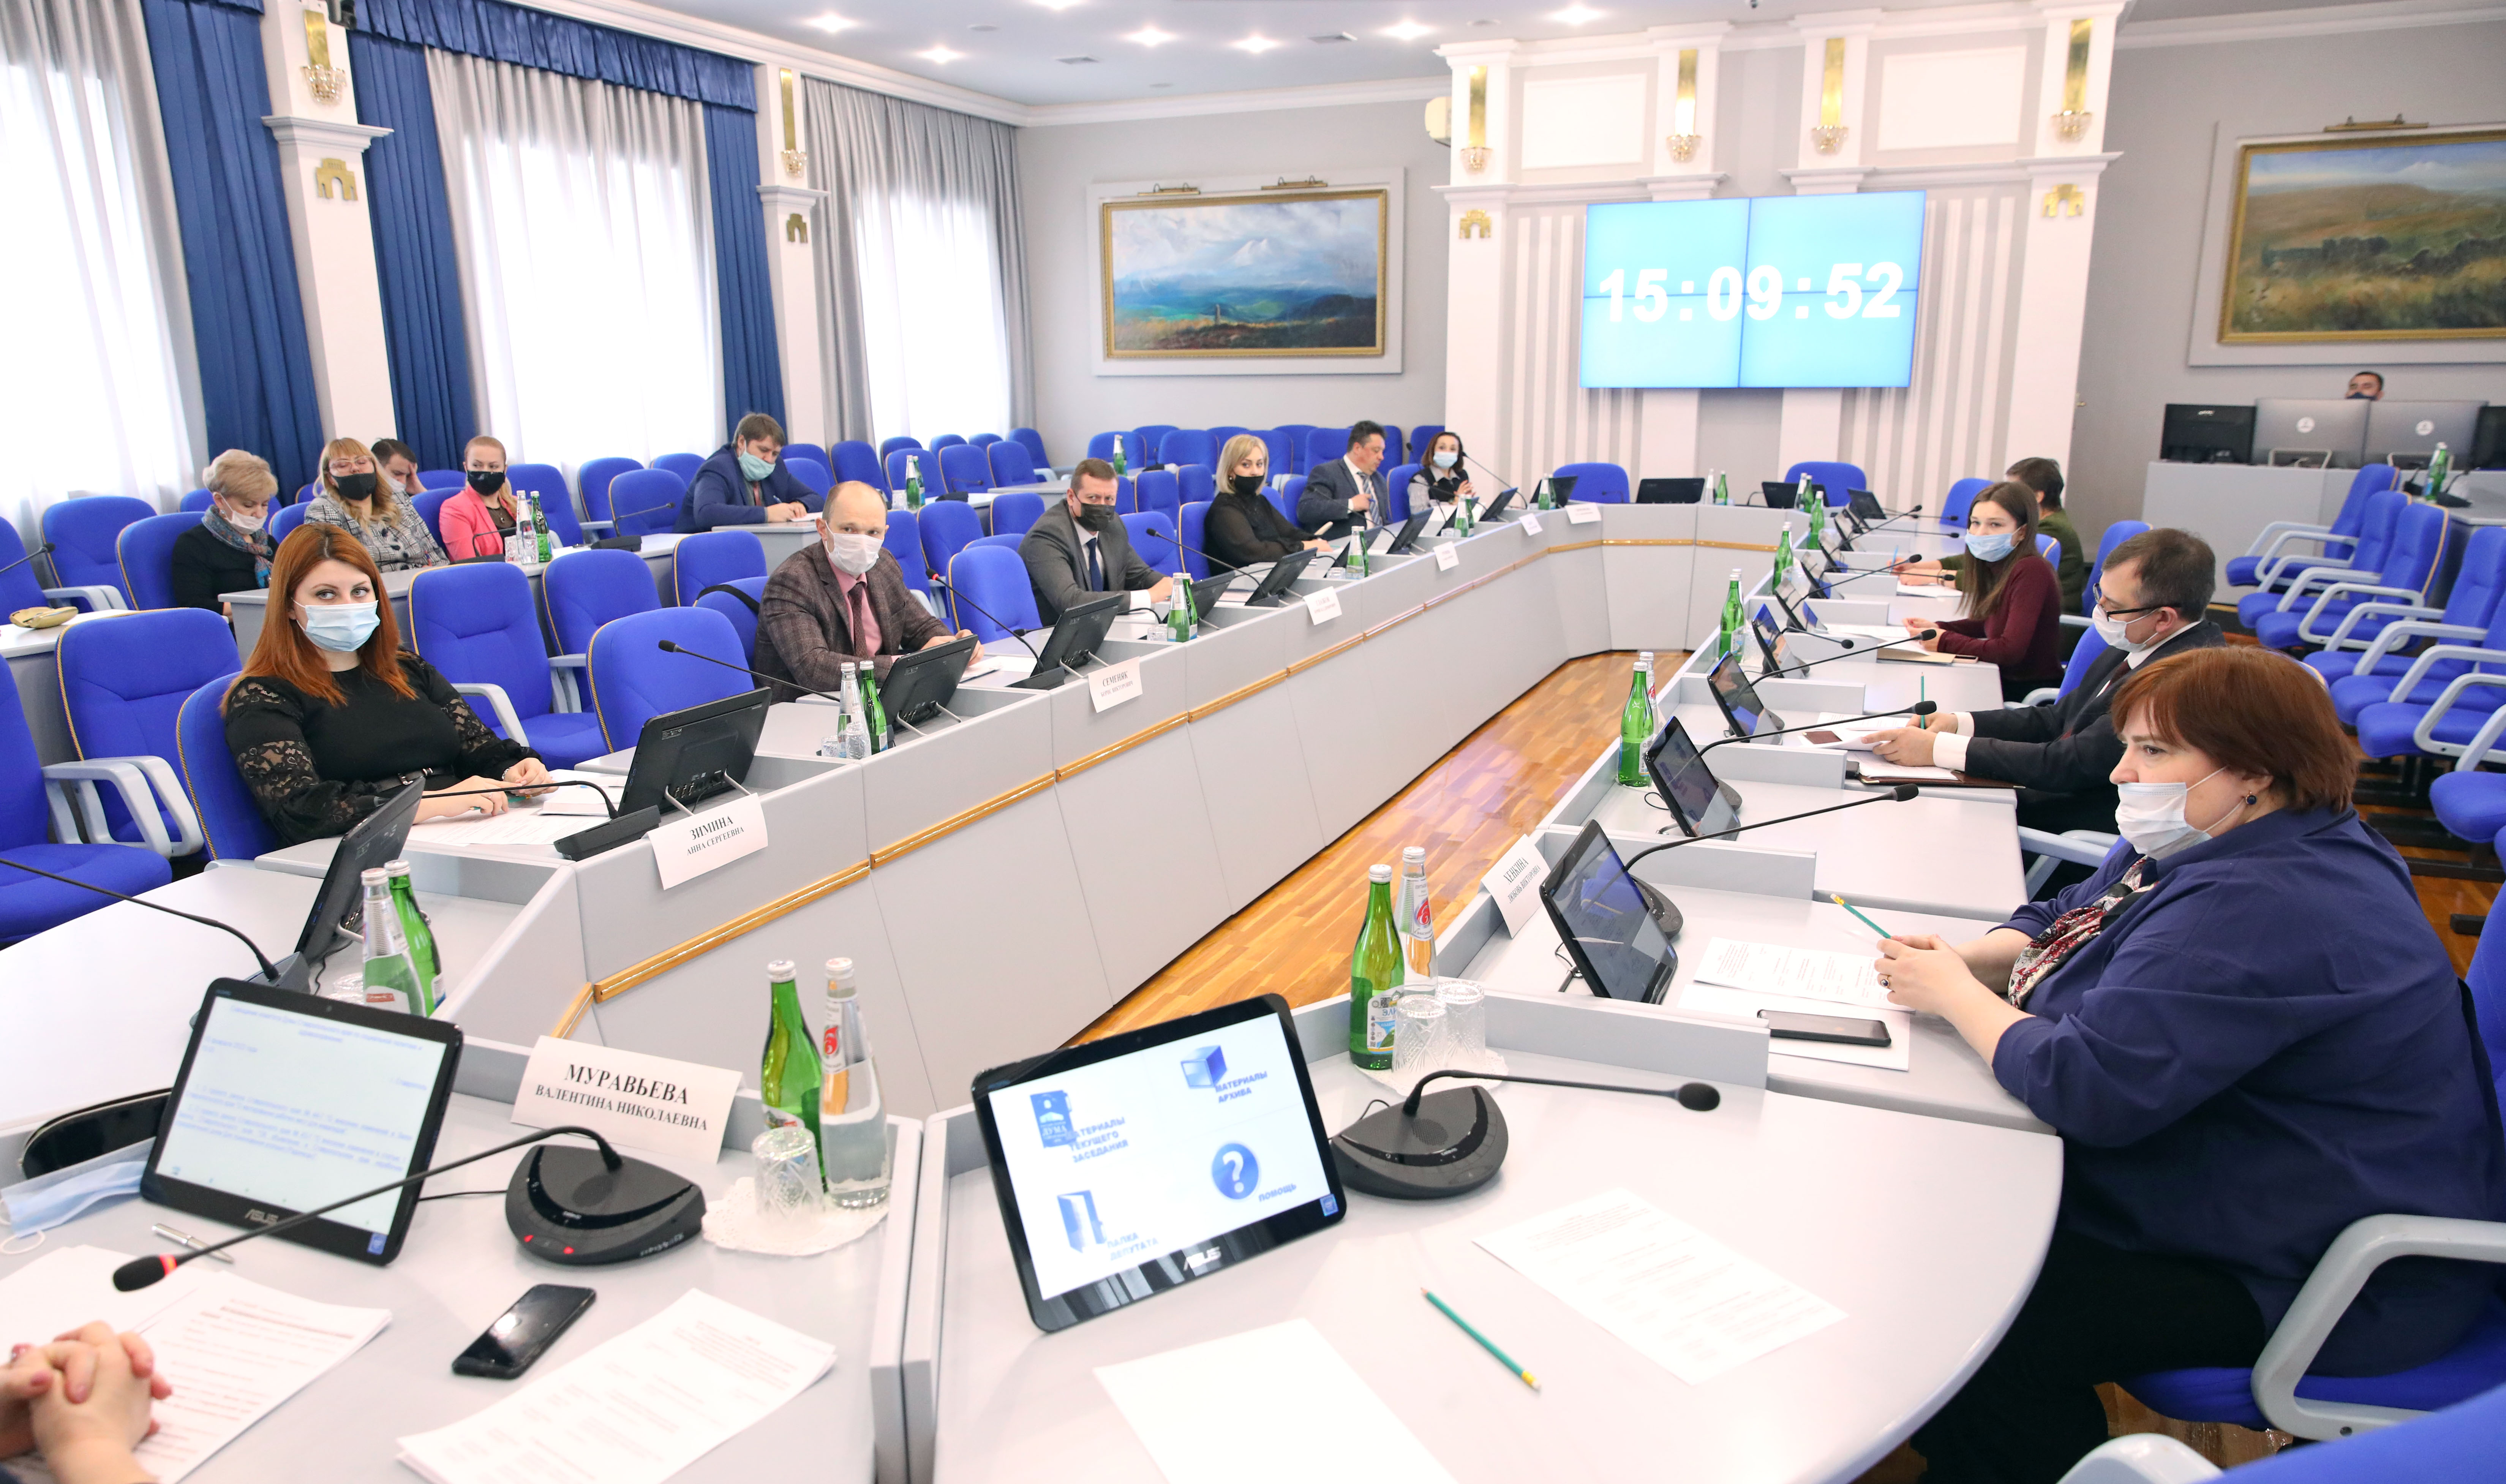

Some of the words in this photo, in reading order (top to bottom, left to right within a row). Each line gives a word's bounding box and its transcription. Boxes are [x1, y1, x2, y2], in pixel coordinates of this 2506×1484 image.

[1599, 261, 1904, 322] 15:09:52
[1103, 671, 1128, 687] СЕМЕНЯК
[687, 842, 706, 856] АННА
[707, 826, 744, 847] СЕРГЕЕВНА
[689, 815, 733, 840] ЗИМИНА
[1503, 857, 1529, 885] ХЕНКИНА
[1507, 884, 1522, 904] ЛЮБОВЬ
[1520, 865, 1541, 889] ВИКТОРОВНА
[564, 1064, 688, 1105] МУРАВЬЕВА
[1219, 1087, 1252, 1103] АРХИВА
[536, 1084, 613, 1111] ВАЛЕНТИНА
[616, 1101, 708, 1130] НИКОЛАЕВНА
[1073, 1139, 1129, 1163] ЗАСЕДАНИЯ
[1183, 1246, 1221, 1271] ASUS
